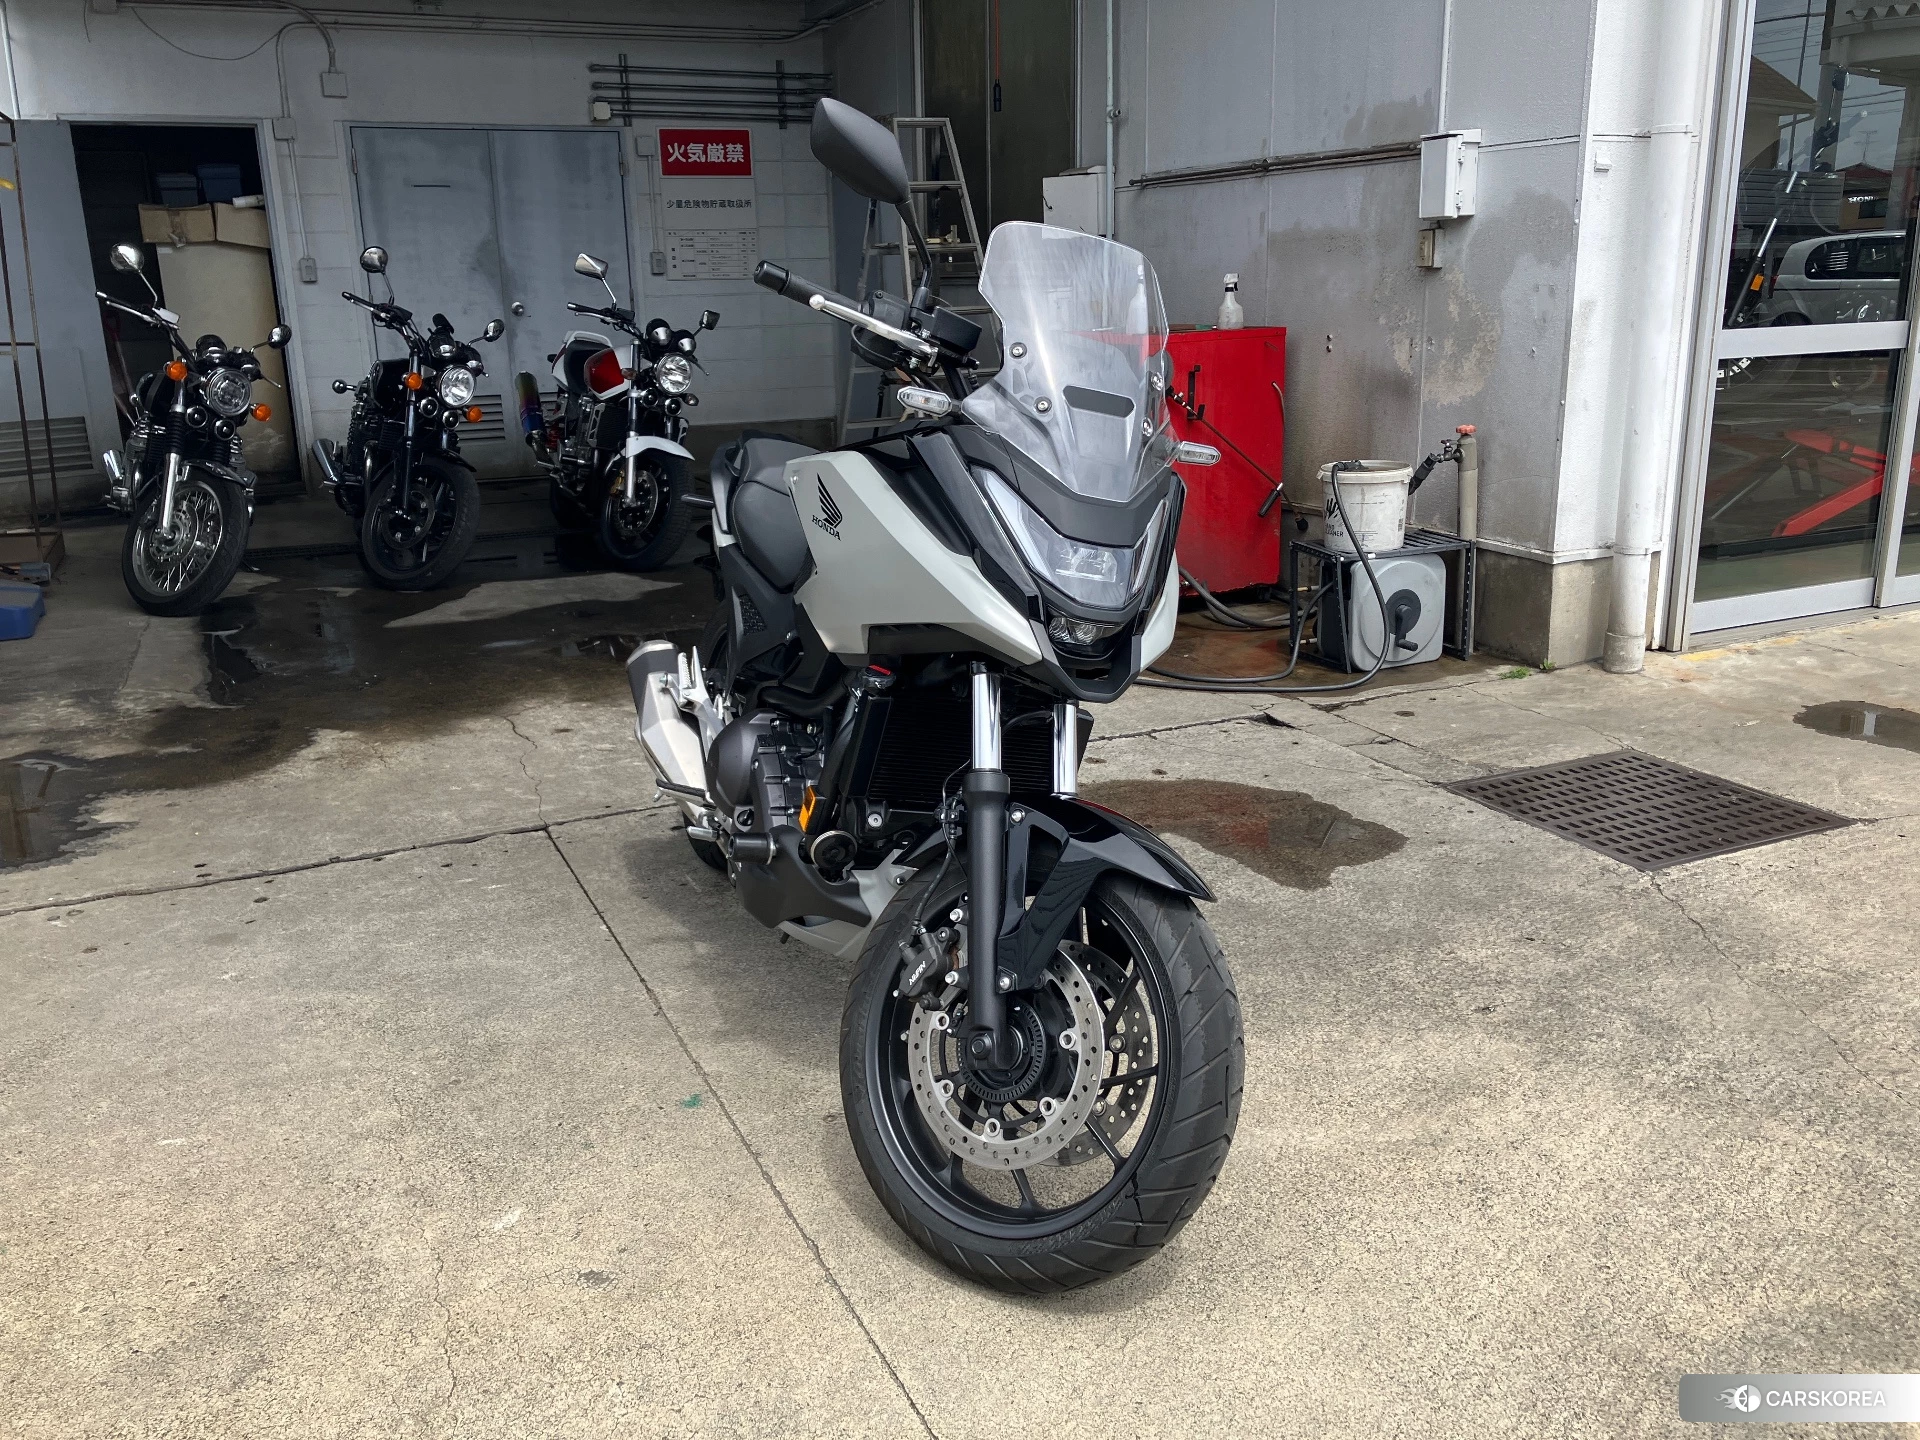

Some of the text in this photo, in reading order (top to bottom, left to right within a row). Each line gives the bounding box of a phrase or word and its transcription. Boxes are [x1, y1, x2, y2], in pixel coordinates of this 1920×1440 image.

[667, 142, 744, 163] 火気厳禁
[666, 199, 752, 209] 少量危険物貯蔵取扱所
[812, 514, 842, 541] HONDA
